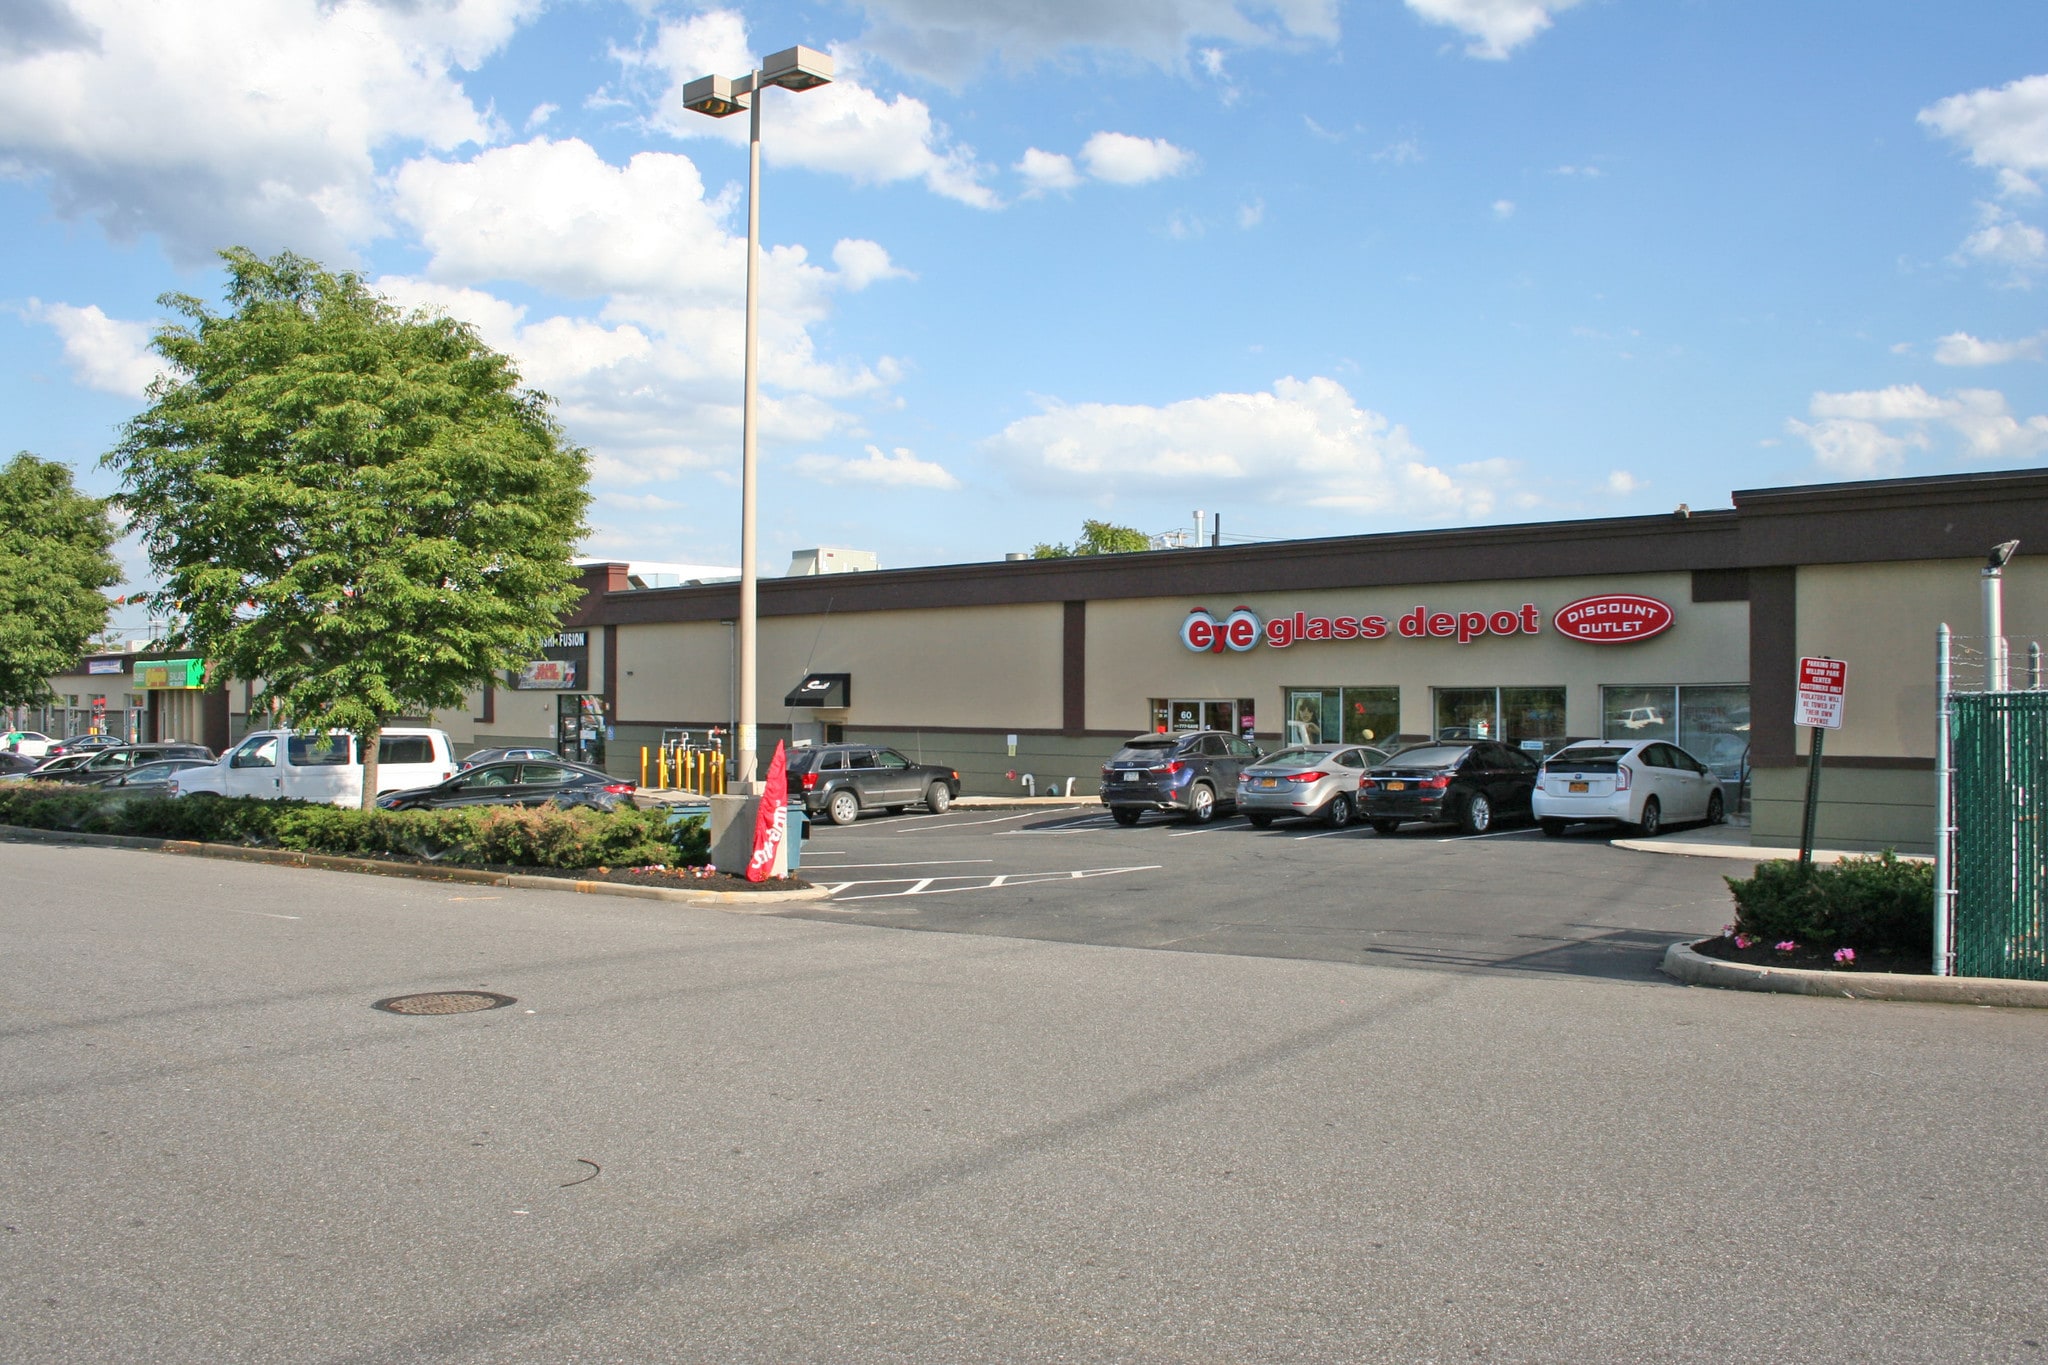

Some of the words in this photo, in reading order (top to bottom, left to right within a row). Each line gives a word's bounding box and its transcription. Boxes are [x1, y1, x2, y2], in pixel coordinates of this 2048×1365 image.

[1566, 602, 1658, 624] DISCOUNT
[1188, 619, 1254, 654] eye
[1266, 611, 1387, 649] glass
[1397, 603, 1539, 644] depot
[1578, 620, 1643, 635] OUTLET
[559, 633, 585, 647] FUSION
[1180, 711, 1192, 719] 60
